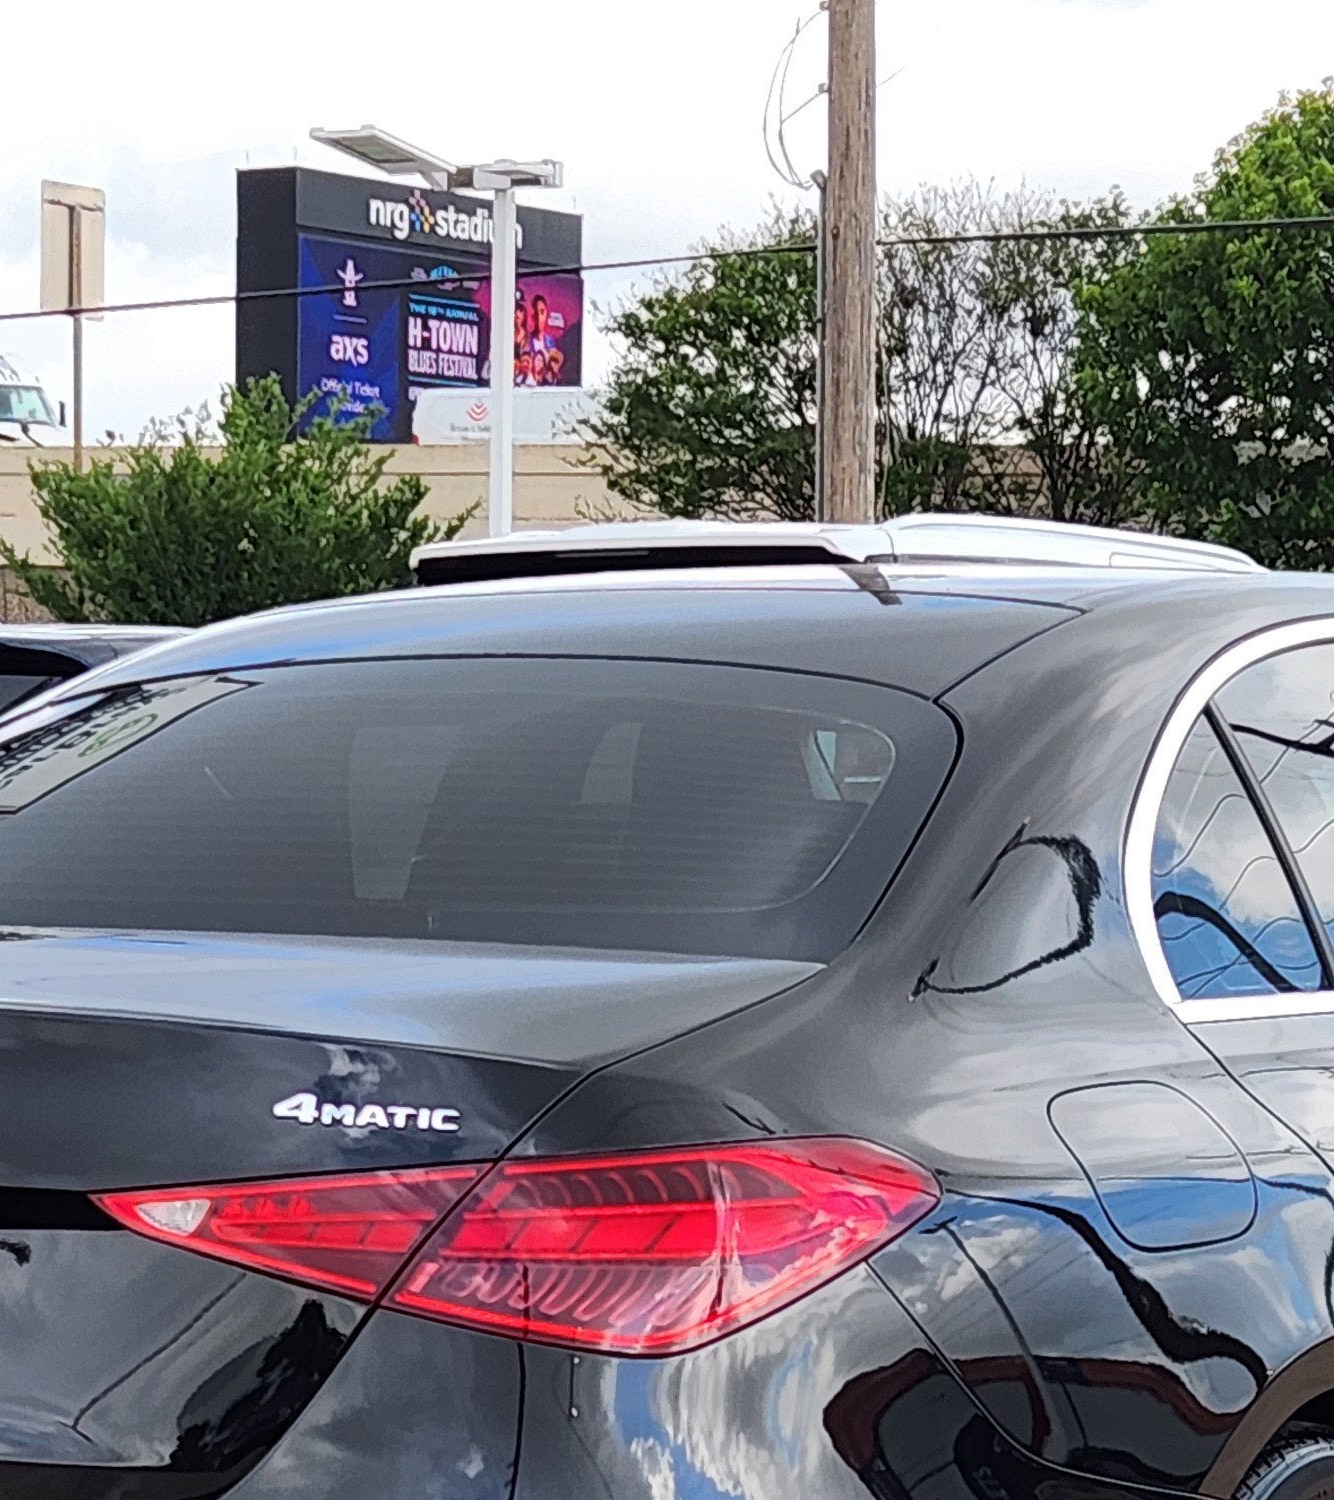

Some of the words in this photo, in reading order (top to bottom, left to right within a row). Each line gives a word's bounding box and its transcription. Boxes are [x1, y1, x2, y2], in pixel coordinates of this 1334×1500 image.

[369, 198, 410, 240] nrg
[434, 205, 523, 249] stadi
[330, 334, 369, 368] axs
[408, 316, 479, 356] H-TOWN
[408, 349, 438, 376] BLUES
[438, 352, 479, 380] FESTIVAL
[272, 1092, 461, 1131] 4MATIC
